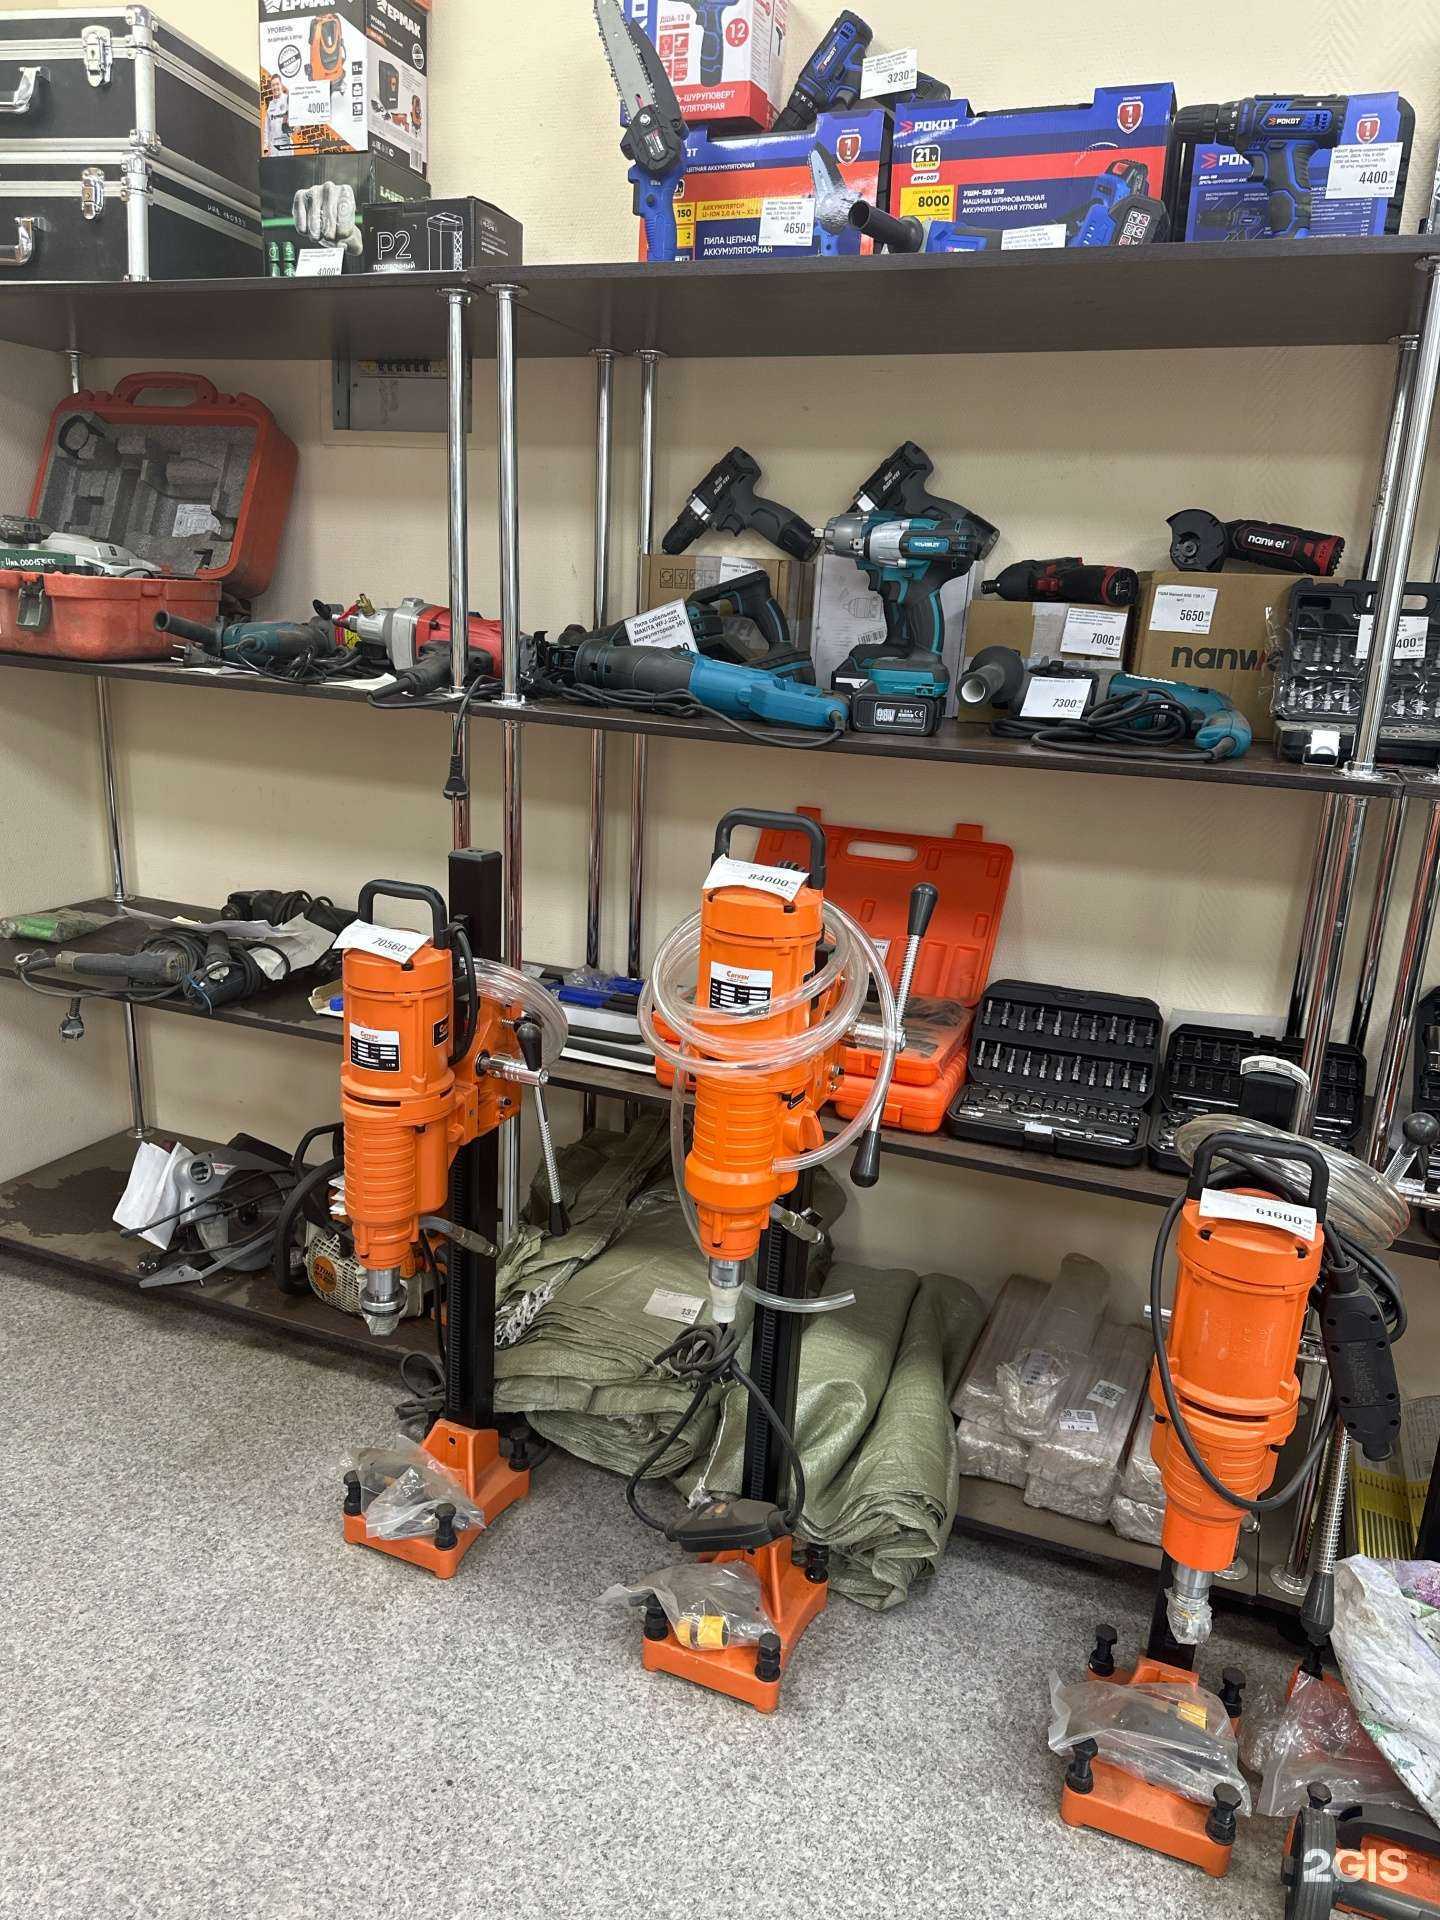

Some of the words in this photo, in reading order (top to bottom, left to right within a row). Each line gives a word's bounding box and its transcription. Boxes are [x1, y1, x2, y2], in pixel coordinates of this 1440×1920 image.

[387, 3, 421, 38] ЕРМАК
[728, 22, 746, 39] 12
[888, 70, 909, 83] 3230
[677, 90, 735, 102] Ь-ШУРУПОВЕРТ
[308, 102, 326, 114] 4000
[681, 103, 725, 112] УЛЯТОРНАЯ
[1126, 105, 1134, 123] 1
[914, 119, 959, 132] РОКОТ
[1276, 117, 1301, 125] РОКОТ
[845, 138, 852, 156] 1
[915, 148, 930, 162] 21
[1218, 153, 1250, 166] РОК
[707, 162, 755, 171] АККУМУЛЯТОРНАЯ
[1359, 170, 1388, 184] 4400
[918, 195, 950, 207] 8000
[962, 197, 990, 205] МАШИНА
[991, 194, 1045, 204] ШЛИФОВАЛЬНАЯ
[677, 208, 692, 218] 150
[962, 204, 1018, 213] АККУМУЛЯТОРНАЯ
[1018, 203, 1048, 211] УГЛОВАЯ
[784, 222, 806, 234] 4650
[377, 230, 412, 260] P2
[703, 237, 725, 245] ПИЛА
[726, 235, 757, 244] ЦЕПНАЯ
[703, 245, 773, 256] АККУМУЛЯТОРНАЯ
[1247, 534, 1288, 550] nanwei
[648, 609, 677, 624] сабельная
[1179, 609, 1204, 622] 5650
[633, 625, 655, 636] MAKITA
[633, 624, 676, 644] аккумуляторная
[1090, 632, 1115, 646] 7000
[1052, 698, 1077, 708] 7300
[371, 937, 407, 952] 70560
[1255, 1207, 1302, 1225] 61600
